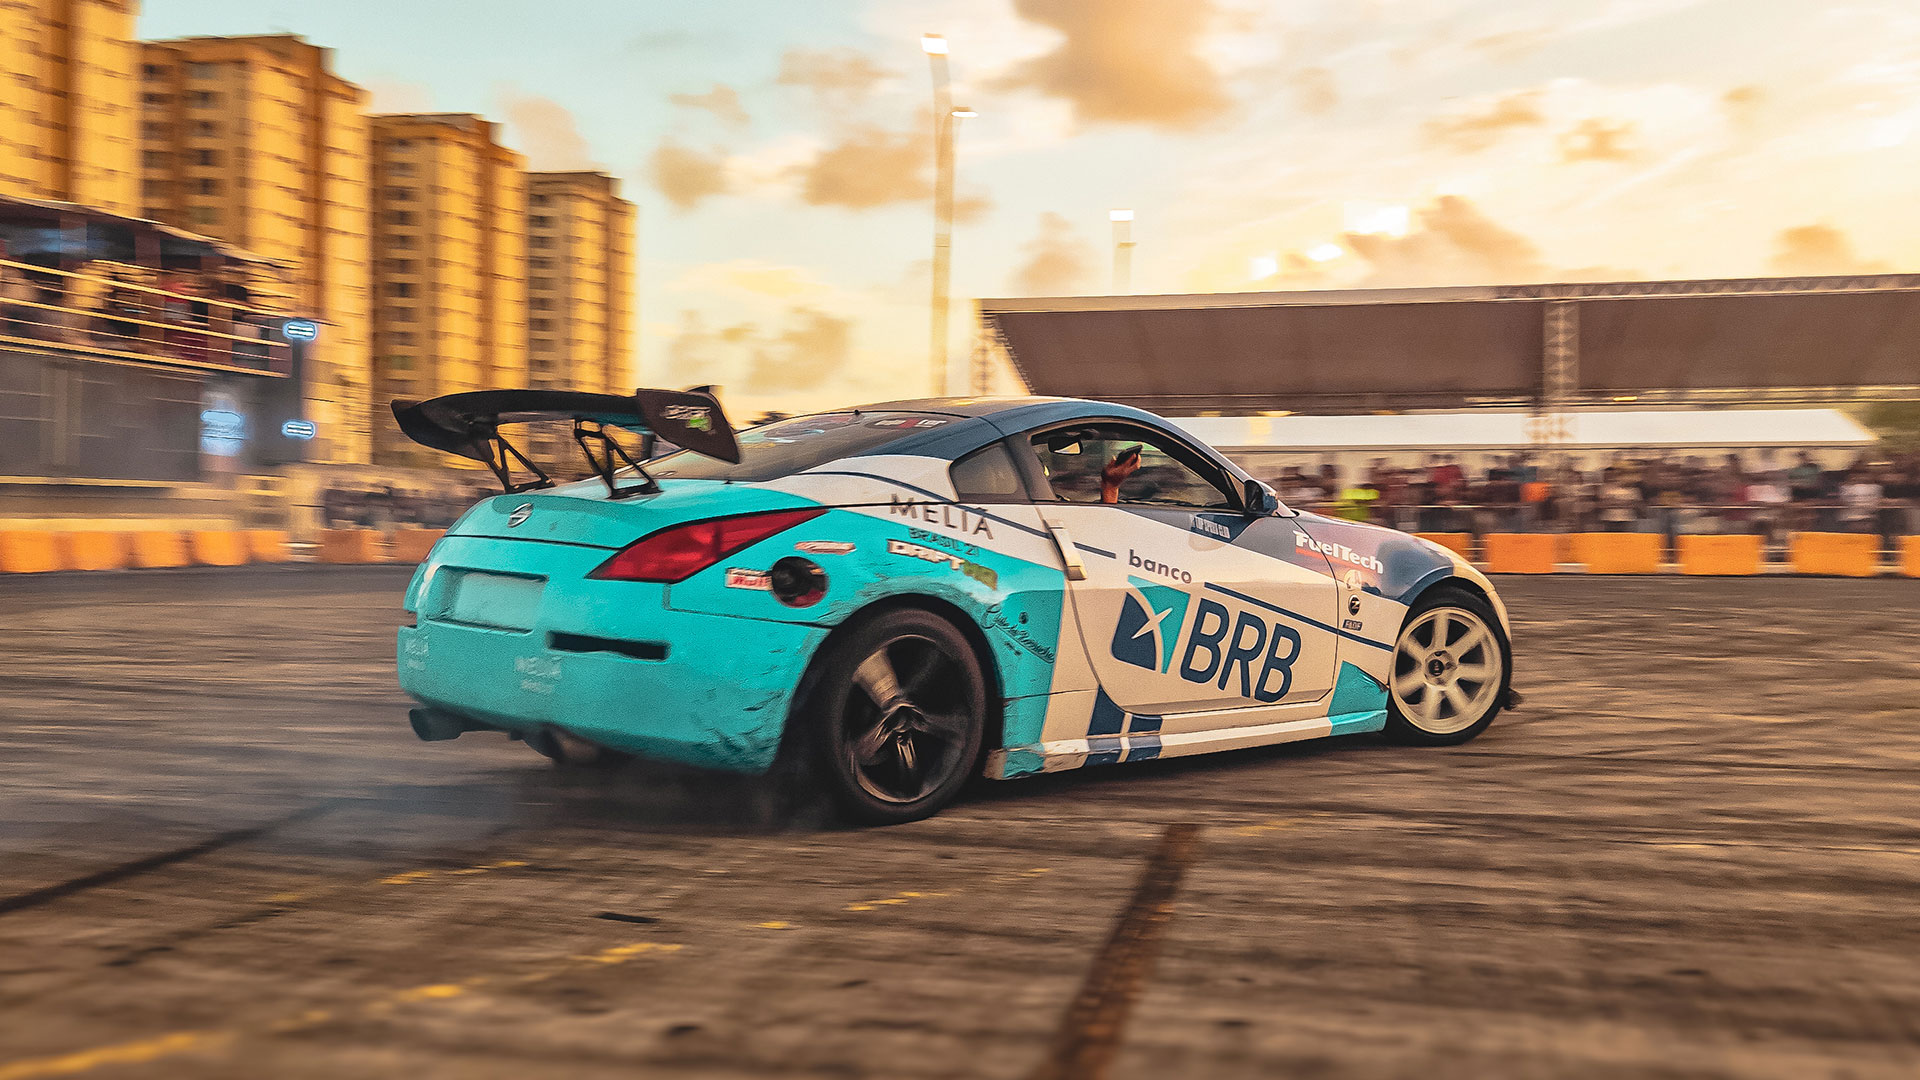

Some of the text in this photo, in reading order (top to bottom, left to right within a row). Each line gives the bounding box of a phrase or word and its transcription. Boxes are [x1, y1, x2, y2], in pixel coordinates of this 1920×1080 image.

[1129, 549, 1192, 584] banco
[1293, 530, 1384, 575] FuelTech
[1180, 598, 1302, 703] BRB
